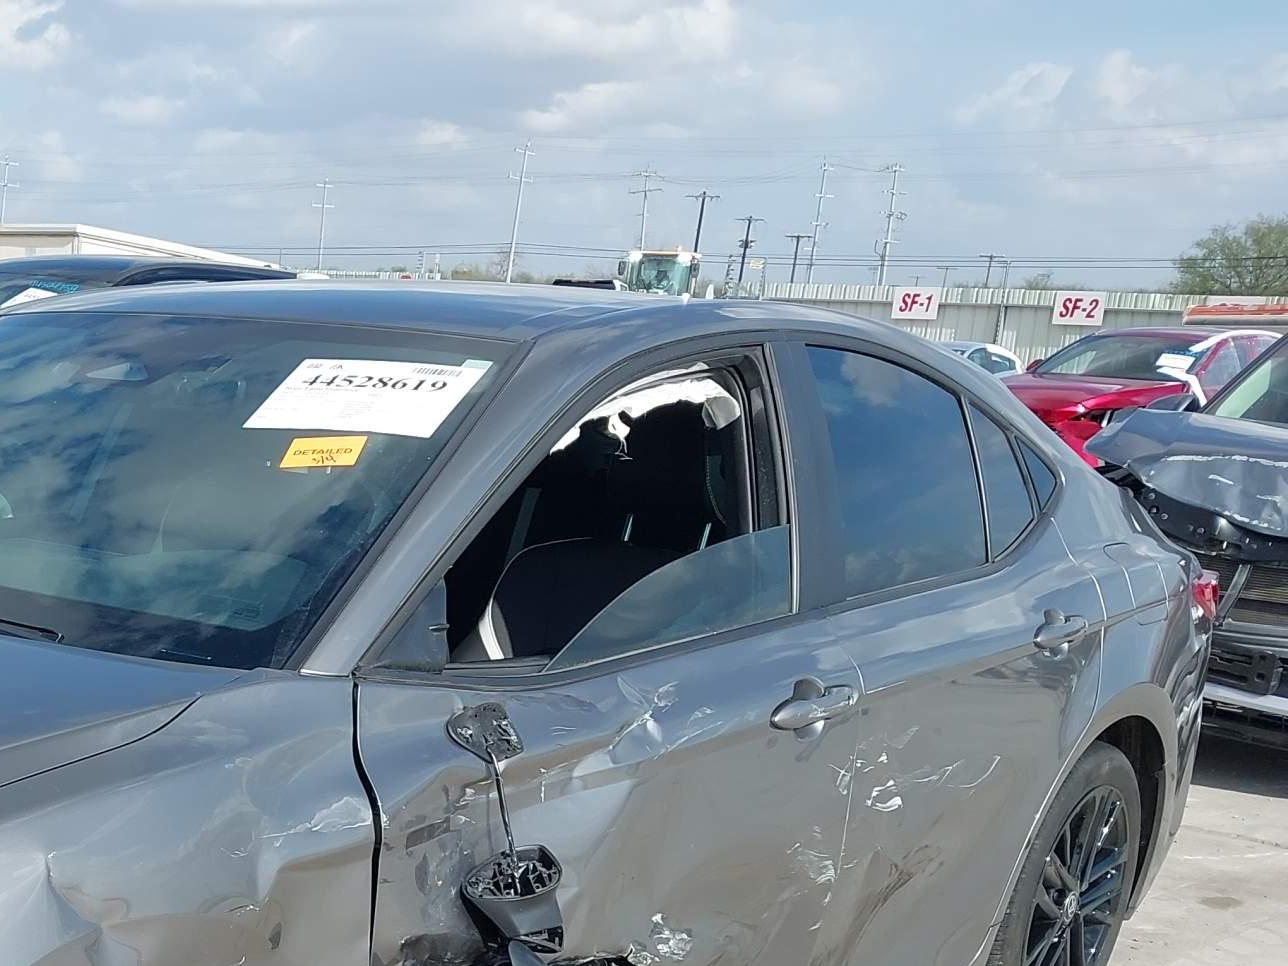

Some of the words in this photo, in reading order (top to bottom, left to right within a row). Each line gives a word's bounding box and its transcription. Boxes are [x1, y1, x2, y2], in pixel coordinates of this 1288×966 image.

[898, 293, 934, 313] SF-1
[1058, 297, 1100, 319] SF-2
[301, 374, 449, 392] 44528619
[292, 447, 353, 456] DETAILED
